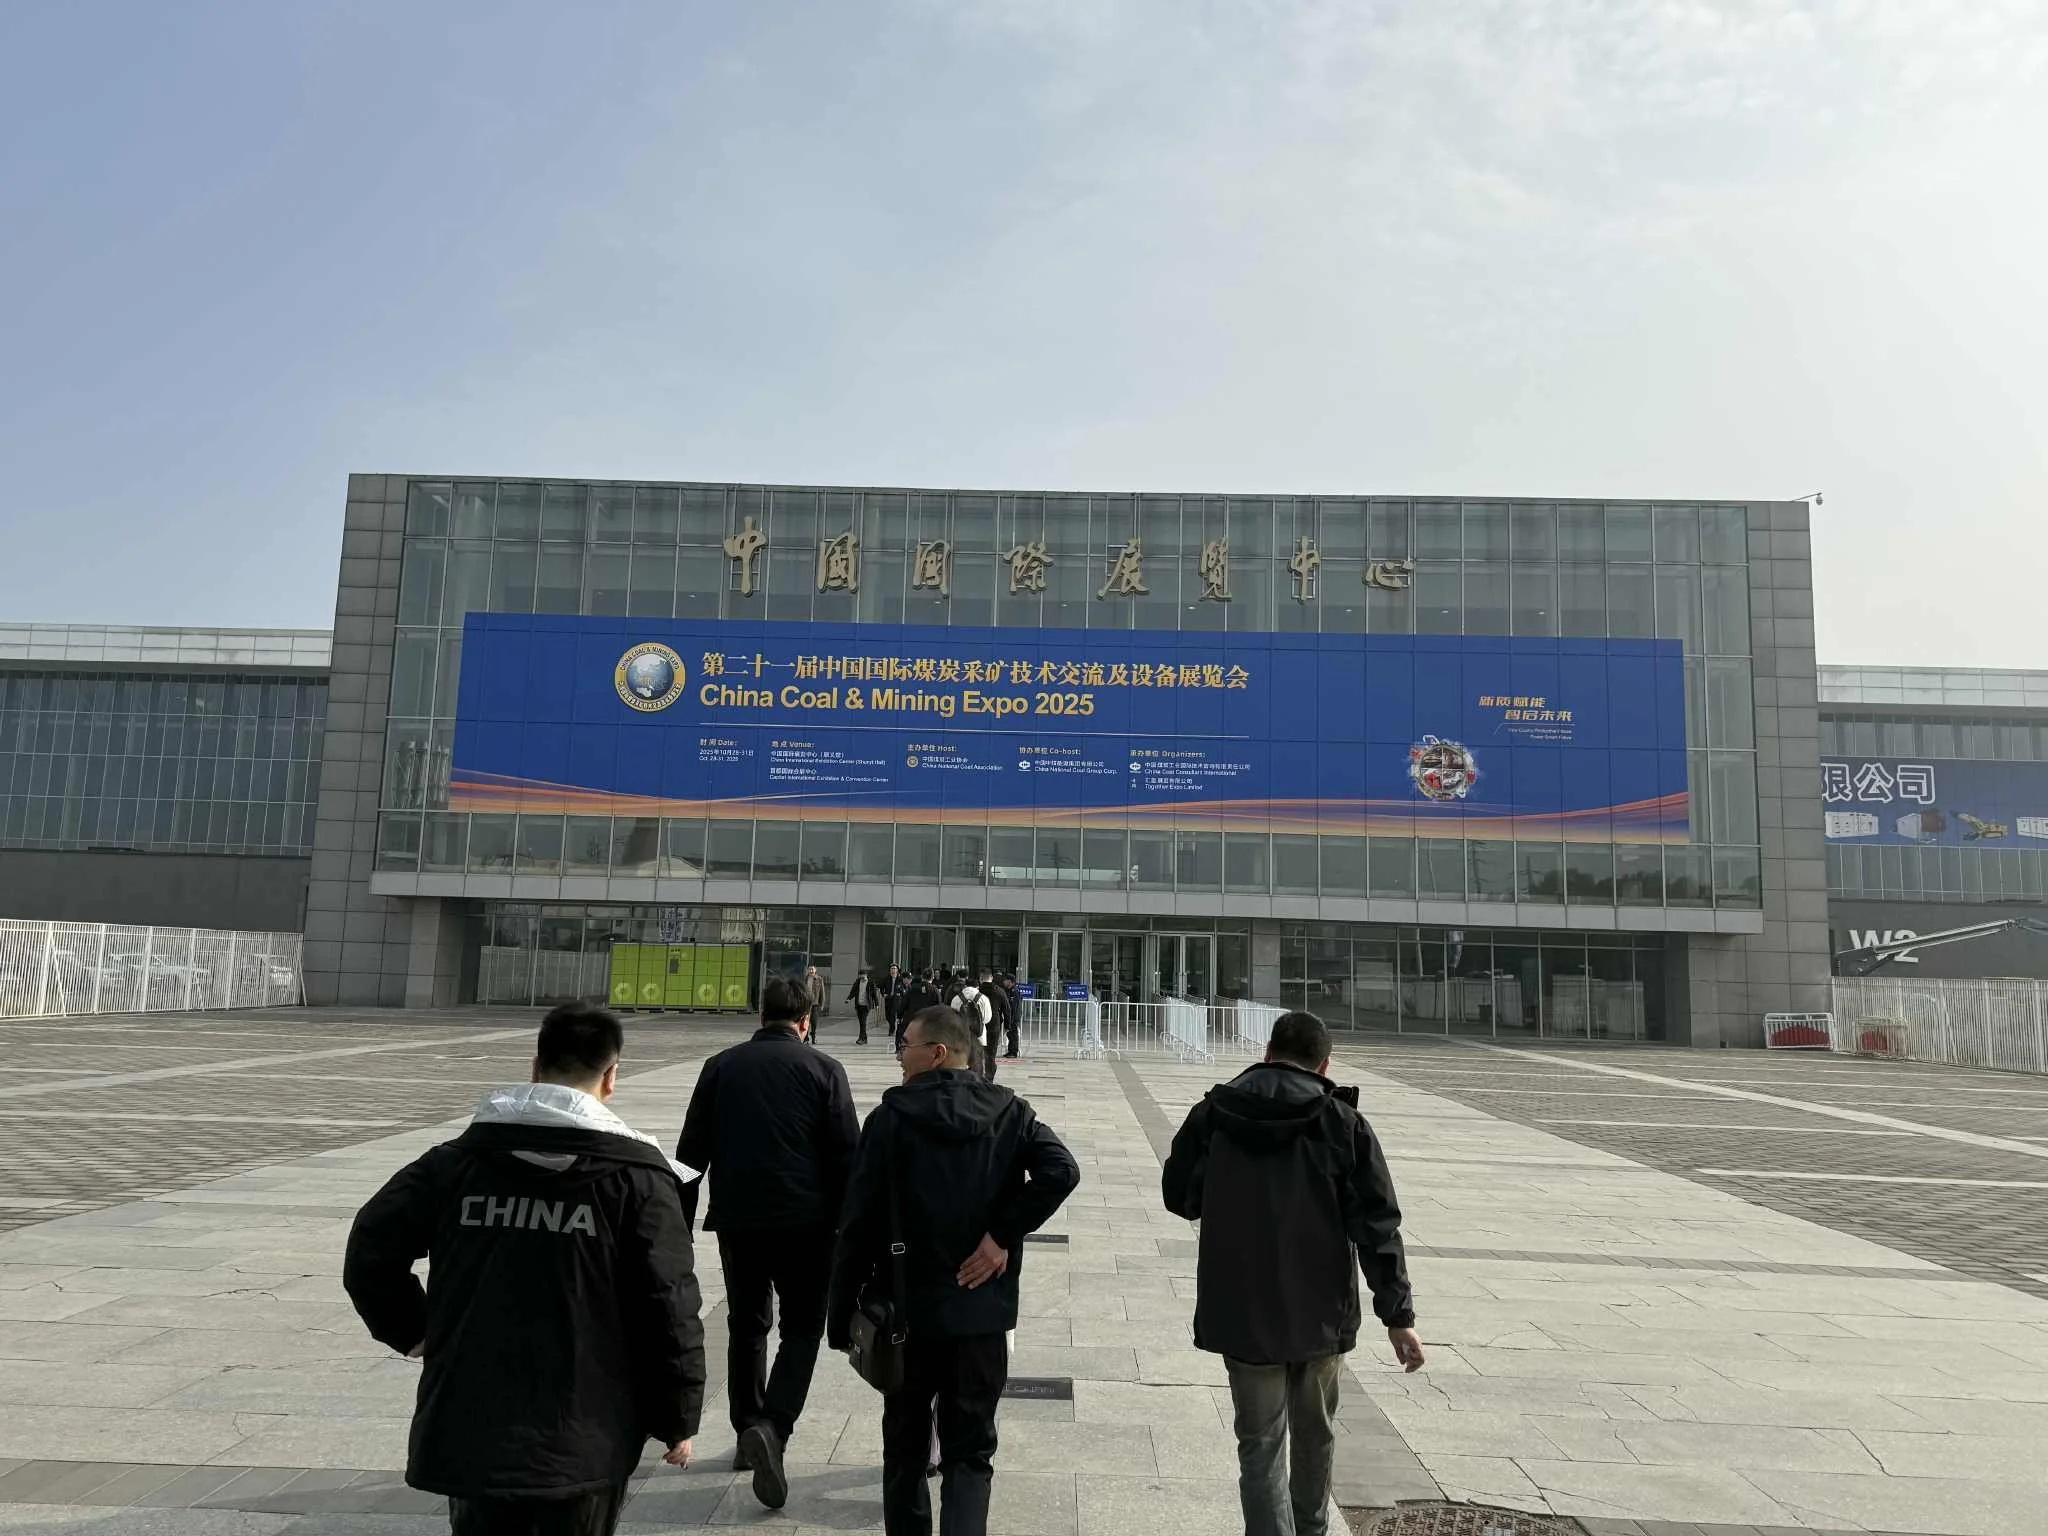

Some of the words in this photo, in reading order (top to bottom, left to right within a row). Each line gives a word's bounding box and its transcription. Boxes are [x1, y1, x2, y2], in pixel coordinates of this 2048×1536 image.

[701, 651, 1250, 690] 第二十一届中国国际煤炭采矿技术交流及设备展览会
[700, 683, 774, 708] China
[781, 685, 838, 709] Coal
[845, 687, 865, 710] &
[872, 687, 956, 718] Mining
[963, 690, 1029, 719] Expo
[1035, 692, 1095, 716] 2025
[1505, 709, 1573, 721] 智启未来
[1049, 747, 1081, 755] Co-host:
[1161, 750, 1206, 759] Organizers:
[1848, 929, 1919, 963] W2
[460, 1195, 597, 1237] CHINA
